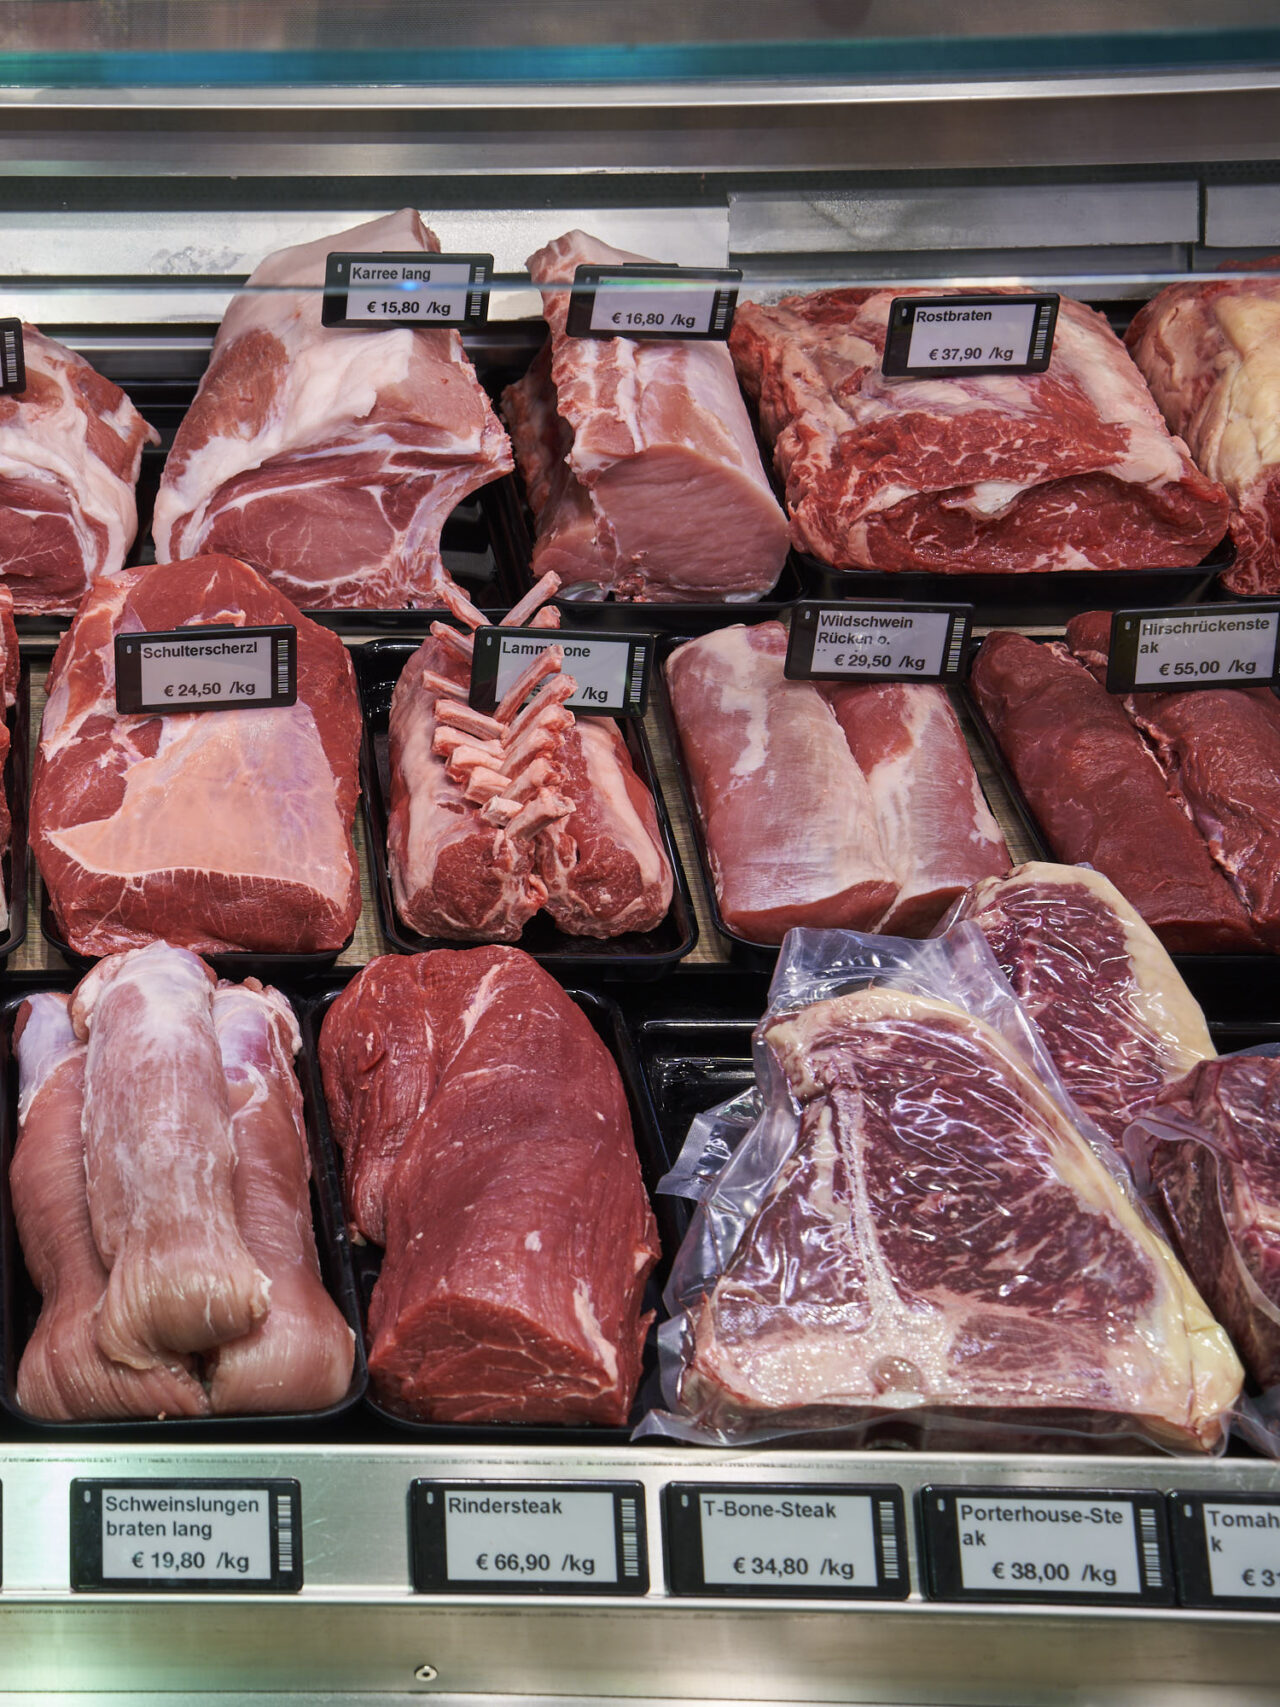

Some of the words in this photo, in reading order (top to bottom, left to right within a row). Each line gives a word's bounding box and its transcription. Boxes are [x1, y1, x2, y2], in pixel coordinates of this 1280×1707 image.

[352, 267, 398, 280] Karree
[402, 267, 431, 283] lang
[367, 301, 377, 313] €
[381, 301, 420, 315] 15,80
[426, 301, 451, 316] /kg
[916, 310, 992, 323] Rostbraten
[611, 312, 622, 324] €
[626, 313, 664, 326] 16,80
[670, 314, 696, 328] /kg
[929, 348, 939, 361] €
[941, 347, 982, 362] 37,90
[989, 347, 1014, 361] /kg
[821, 615, 913, 628] Wildschwein
[1142, 618, 1270, 636] Hirschrückenste
[818, 632, 873, 644] Rücken
[877, 635, 890, 645] o.
[143, 642, 258, 659] Schulterscherzl
[502, 641, 591, 657] Lammone
[1140, 641, 1159, 654] ak
[834, 654, 845, 666] €
[848, 654, 892, 669] 29,50
[898, 655, 926, 671] /kg
[1159, 663, 1170, 676] €
[1173, 660, 1220, 676] 55,00
[1228, 659, 1257, 675] /kg
[164, 685, 174, 697] €
[178, 682, 221, 697] 24,50
[229, 681, 255, 696] /kg
[582, 686, 608, 703] /kg
[106, 1496, 259, 1516] Schweinslungen
[449, 1497, 562, 1514] Rindersteak
[703, 1500, 836, 1518] T-Bone-Steak
[961, 1505, 1123, 1524] Porterhouse-Ste
[106, 1520, 166, 1536] braten
[173, 1521, 212, 1541] lang
[963, 1530, 986, 1546] ak
[1211, 1536, 1222, 1552] k
[132, 1551, 144, 1569] €
[151, 1551, 205, 1571] 19,80
[216, 1552, 249, 1573] /kg
[476, 1553, 488, 1571] €
[494, 1553, 550, 1574] 66,90
[561, 1554, 595, 1576] /kg
[733, 1557, 746, 1574] €
[752, 1557, 809, 1577] 34,80
[820, 1558, 854, 1580] /kg
[992, 1562, 1005, 1579] €
[1011, 1562, 1070, 1583] 38,00
[1081, 1564, 1117, 1586] /kg
[1241, 1568, 1256, 1587] €
[1261, 1569, 1280, 1587] 3
